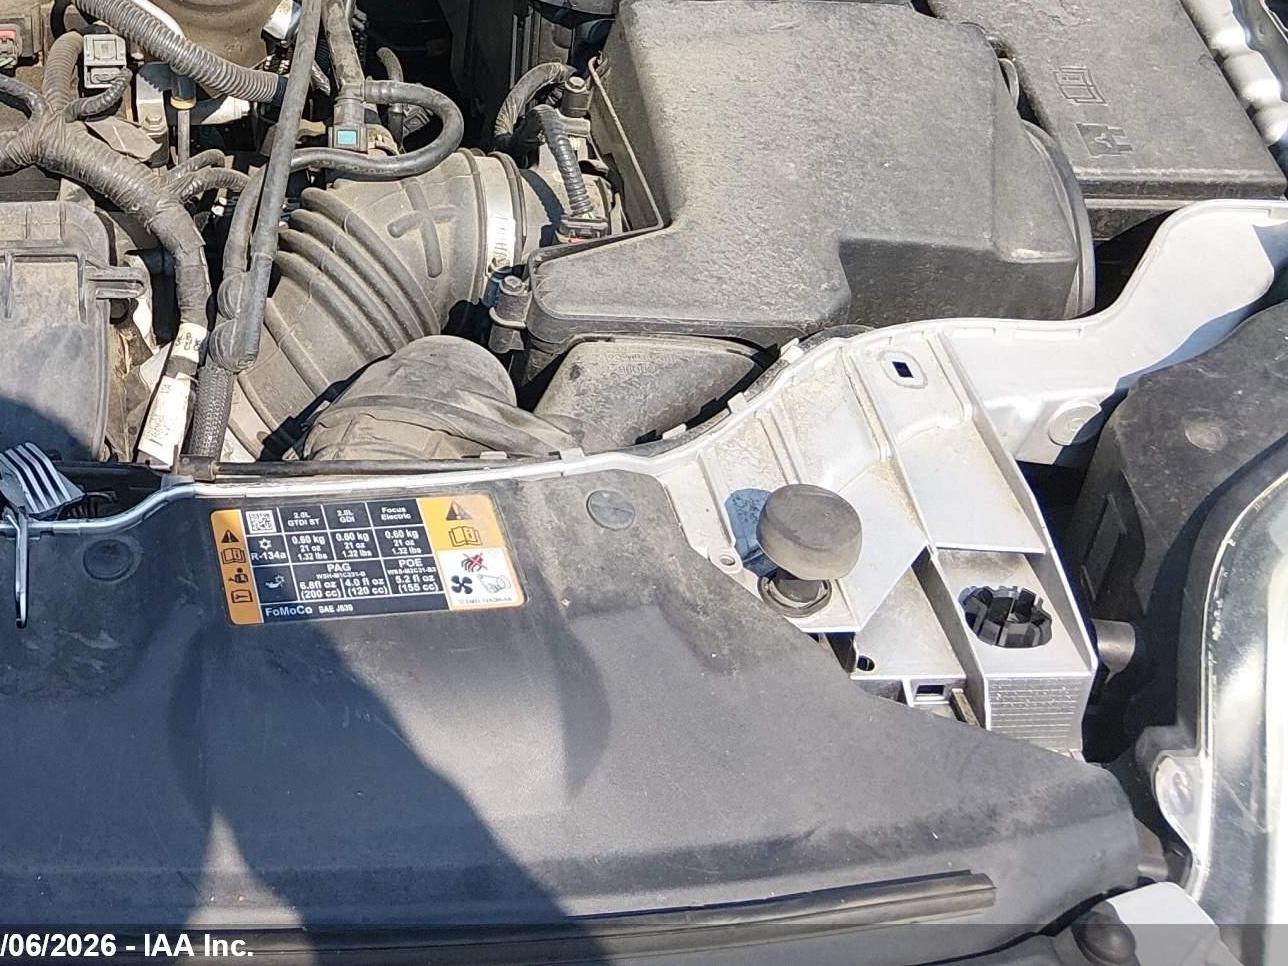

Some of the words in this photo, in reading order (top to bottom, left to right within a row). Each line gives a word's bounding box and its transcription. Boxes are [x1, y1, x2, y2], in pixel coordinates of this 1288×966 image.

[381, 506, 406, 514] Focus
[339, 516, 355, 524] GDI
[380, 513, 411, 521] Electric
[335, 532, 356, 542] 0.60
[357, 531, 370, 542] kg
[384, 529, 405, 539] 0.60
[405, 528, 419, 539] kg
[291, 534, 312, 544] 0.60
[313, 534, 326, 545] kg
[341, 550, 359, 558] 1.32
[359, 549, 372, 557] lbs
[391, 547, 409, 555] 1.32
[409, 546, 422, 554] lbs
[251, 551, 287, 561] R-134a
[297, 553, 314, 561] 1.32
[315, 552, 328, 560] lbs
[326, 562, 352, 572] PAG
[398, 558, 423, 568] POE
[345, 578, 361, 587] 4.0
[362, 577, 370, 586] fl
[395, 574, 411, 584] 5.2
[412, 574, 421, 583] fl
[347, 586, 370, 597] (120
[371, 585, 388, 595] cc)
[398, 583, 421, 594] (155
[422, 582, 439, 592] cc)
[300, 589, 323, 601] (200
[325, 588, 342, 598] cc)
[264, 605, 313, 617] FoMoCo
[318, 604, 336, 614] SAE
